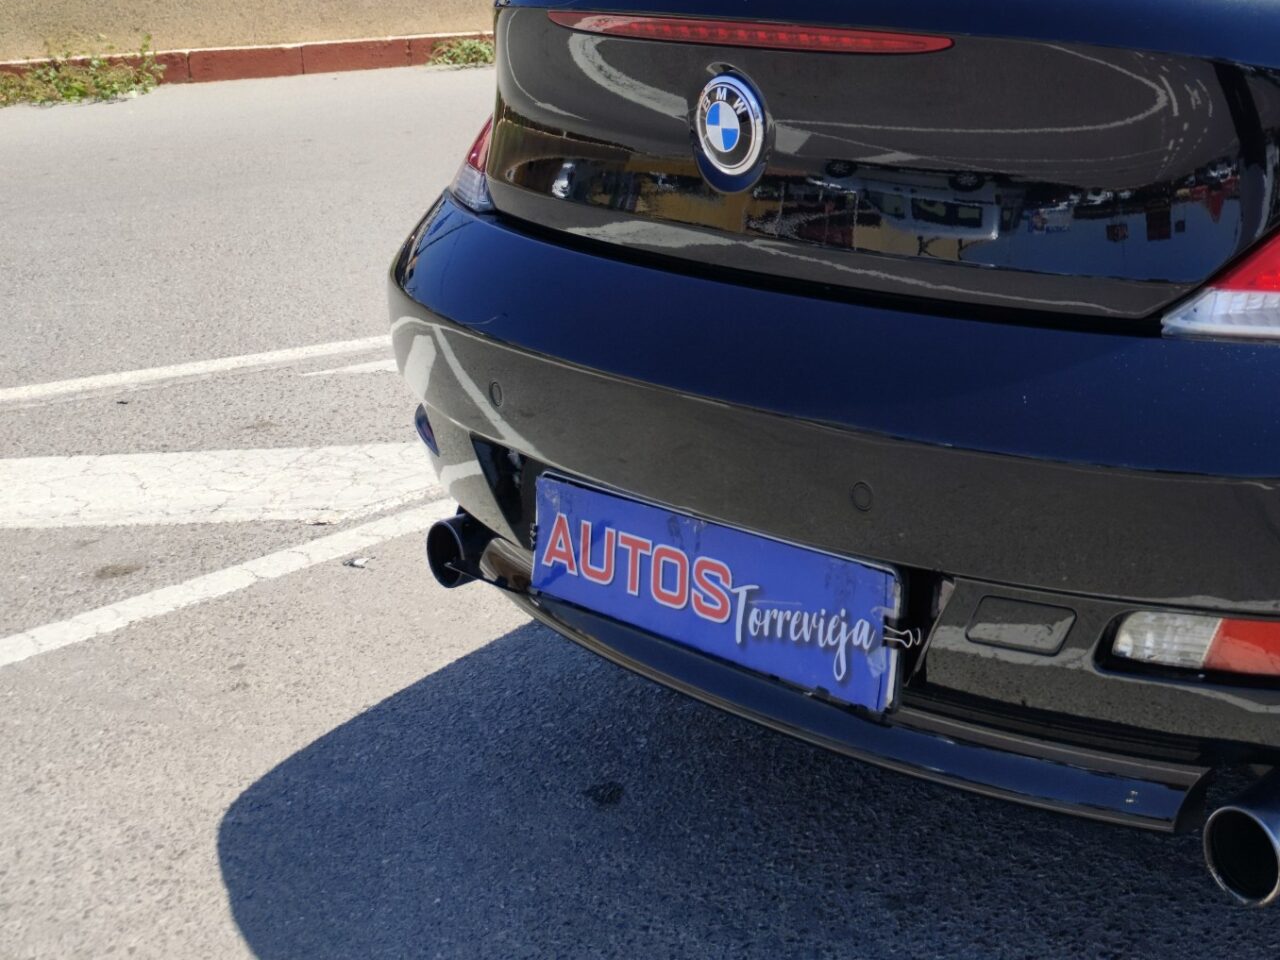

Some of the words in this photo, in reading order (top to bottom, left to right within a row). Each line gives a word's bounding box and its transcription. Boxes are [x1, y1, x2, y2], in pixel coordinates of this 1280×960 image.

[701, 87, 747, 115] BMW
[541, 512, 734, 624] AUTOS
[729, 584, 876, 683] Torrevieja
